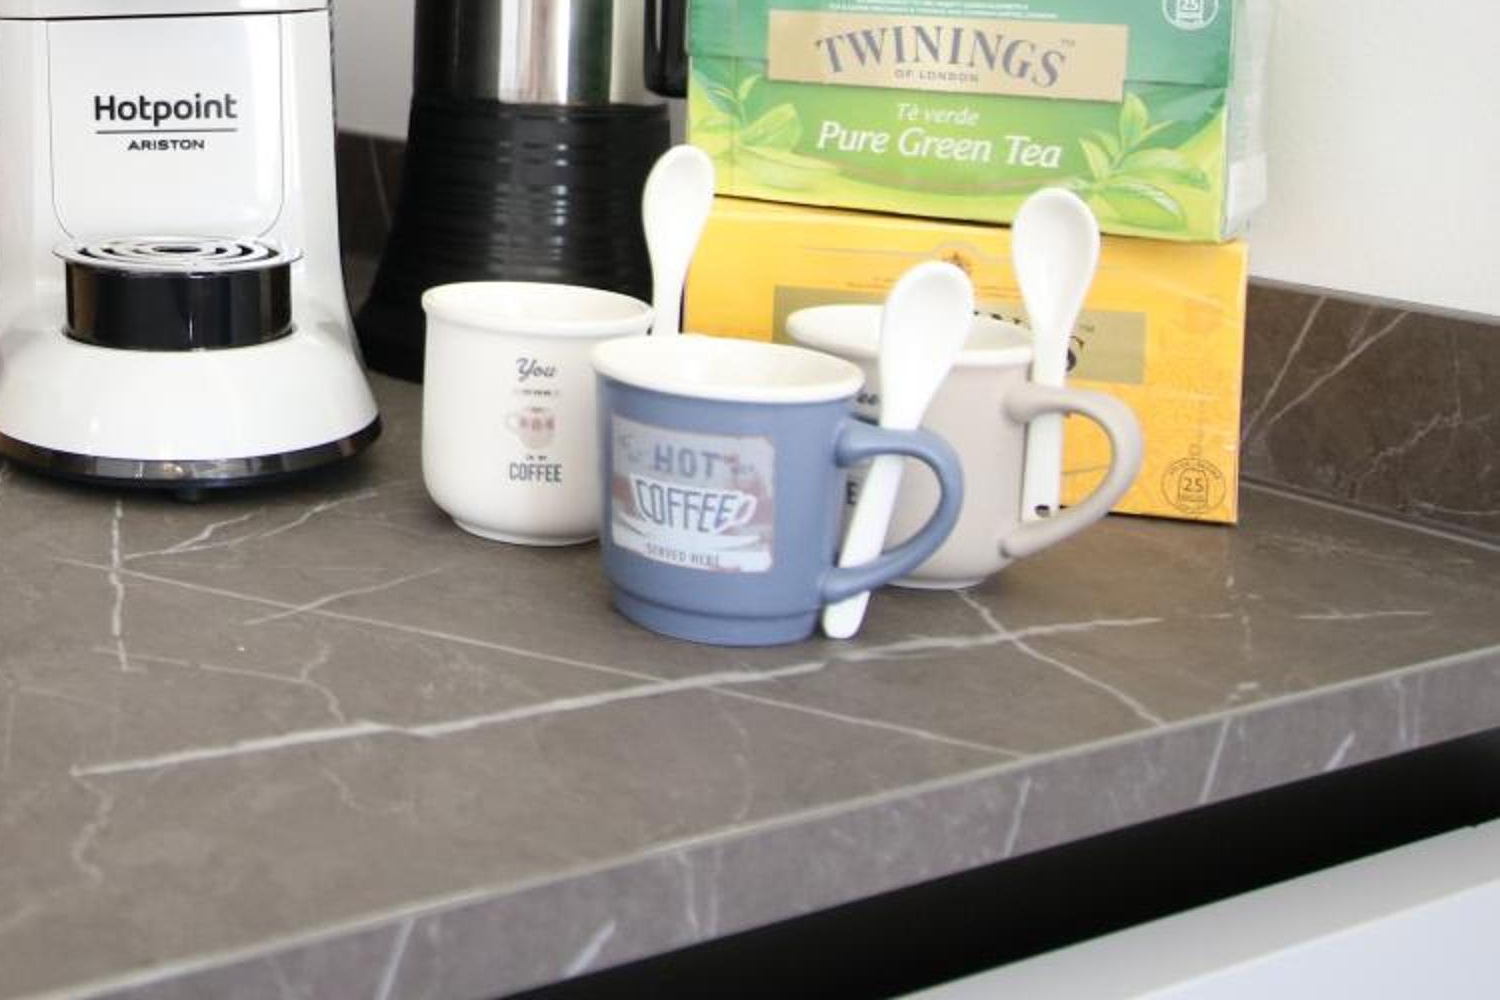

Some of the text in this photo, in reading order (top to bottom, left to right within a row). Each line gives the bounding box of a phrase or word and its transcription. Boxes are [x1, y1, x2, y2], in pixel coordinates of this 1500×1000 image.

[814, 25, 1066, 88] TWININGS
[894, 69, 980, 83] OF LONDON
[94, 92, 238, 127] Hotpoint
[924, 107, 980, 127] verde
[127, 139, 205, 151] ARISTON
[817, 120, 1064, 169] Pure Green Tea
[515, 357, 557, 383] You
[509, 461, 563, 483] COFFEE
[653, 443, 722, 479] HOT
[1182, 476, 1205, 492] 25
[634, 478, 738, 533] COFFEE
